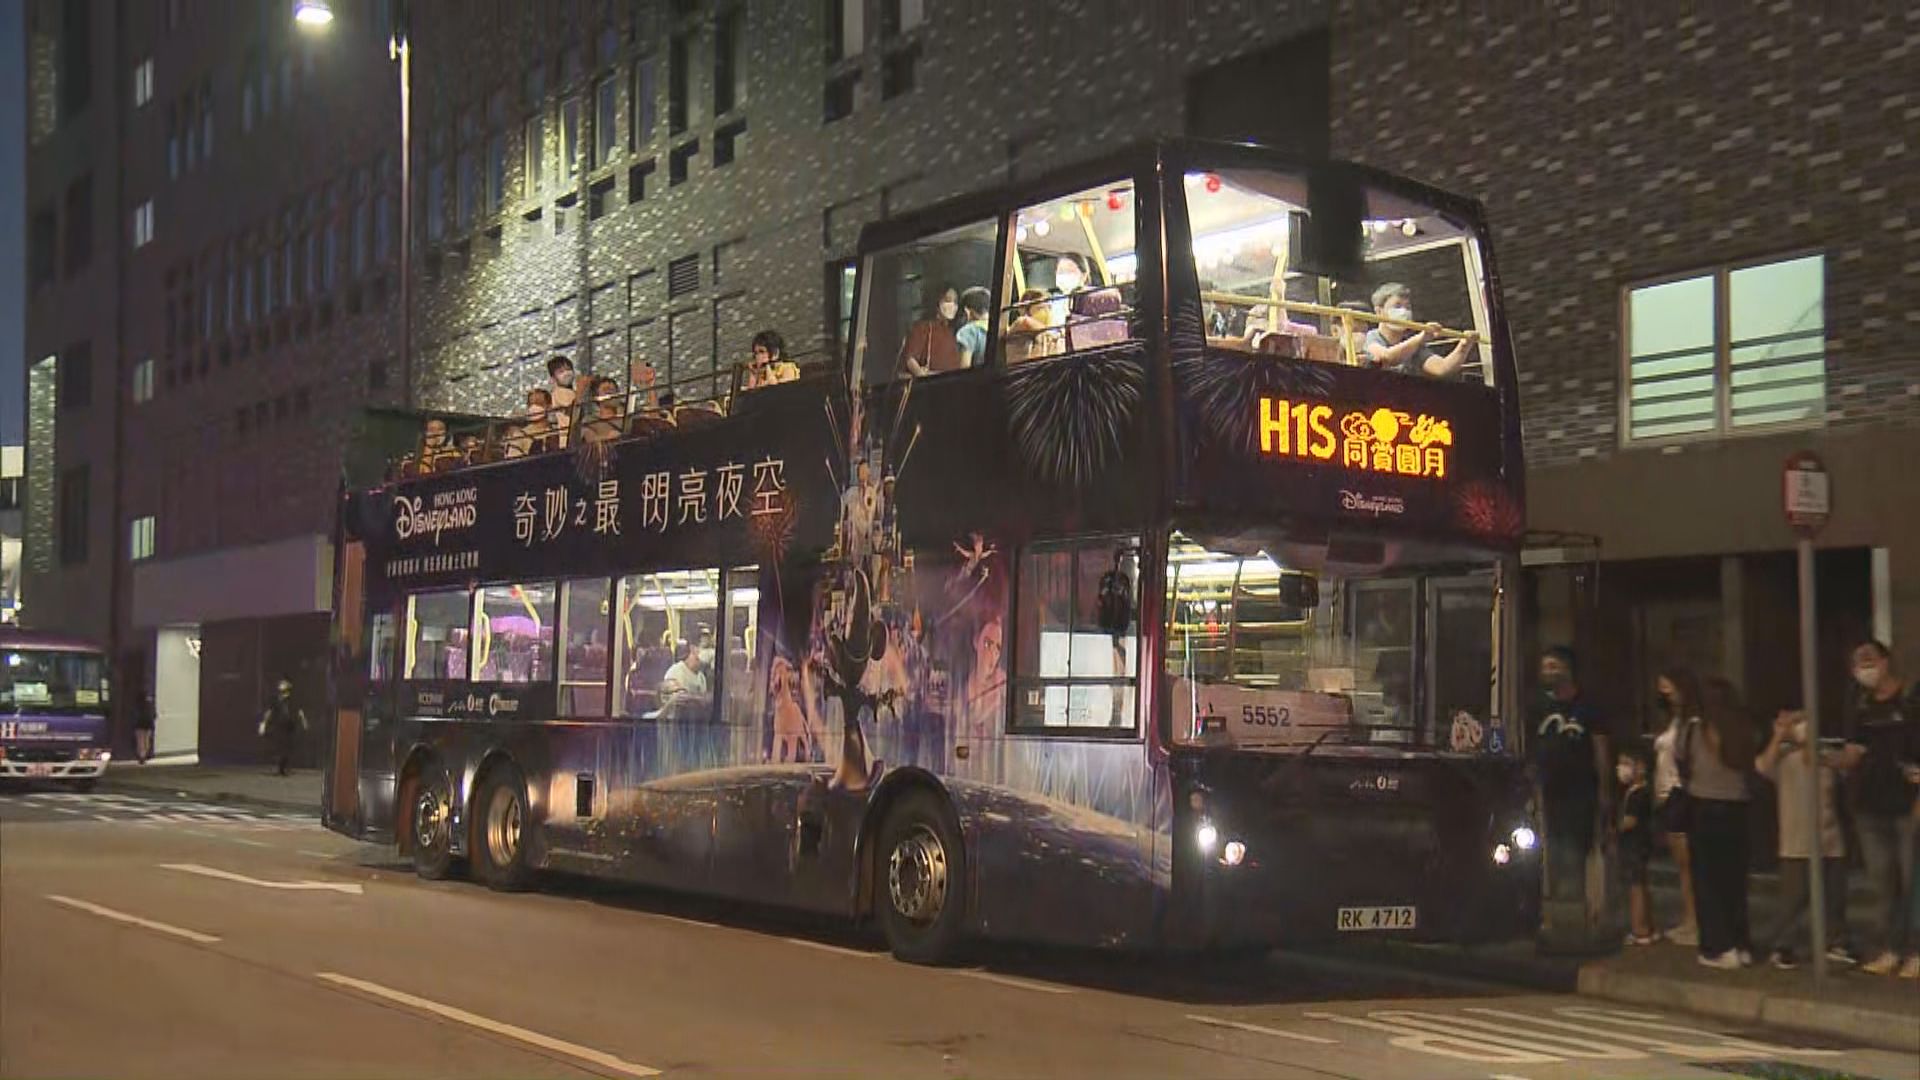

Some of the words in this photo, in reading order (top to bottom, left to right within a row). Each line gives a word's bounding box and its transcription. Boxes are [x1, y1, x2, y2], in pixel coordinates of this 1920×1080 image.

[1259, 397, 1336, 459] H1S
[1343, 438, 1445, 478] 同賞圓月
[434, 492, 457, 508] HONG
[513, 478, 621, 548] 奇妙之最
[641, 455, 786, 534] 閃亮夜空
[1242, 703, 1291, 727] 5552
[1341, 908, 1363, 928] RK
[1371, 907, 1413, 927] 4712
